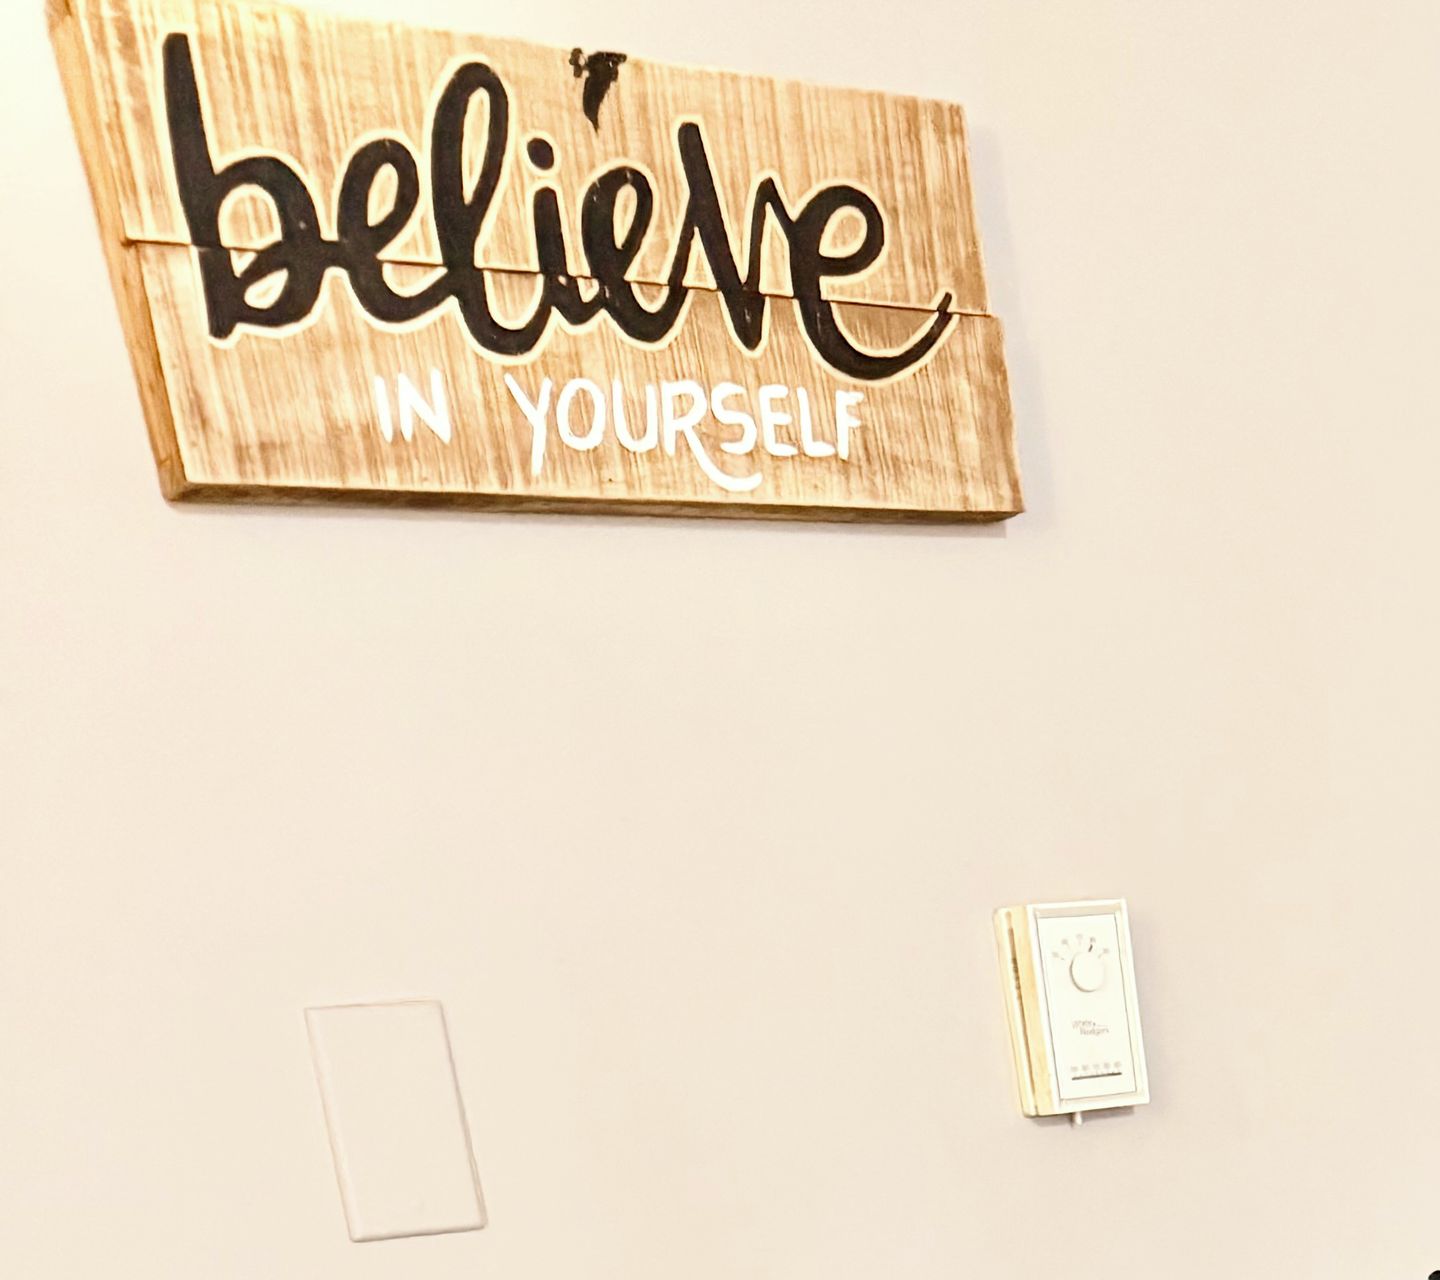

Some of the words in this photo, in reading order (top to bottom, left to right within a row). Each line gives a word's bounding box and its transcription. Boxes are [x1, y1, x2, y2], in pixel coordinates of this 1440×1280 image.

[163, 33, 953, 380] believe
[375, 376, 451, 446] IN
[503, 376, 864, 492] YOURSELF
